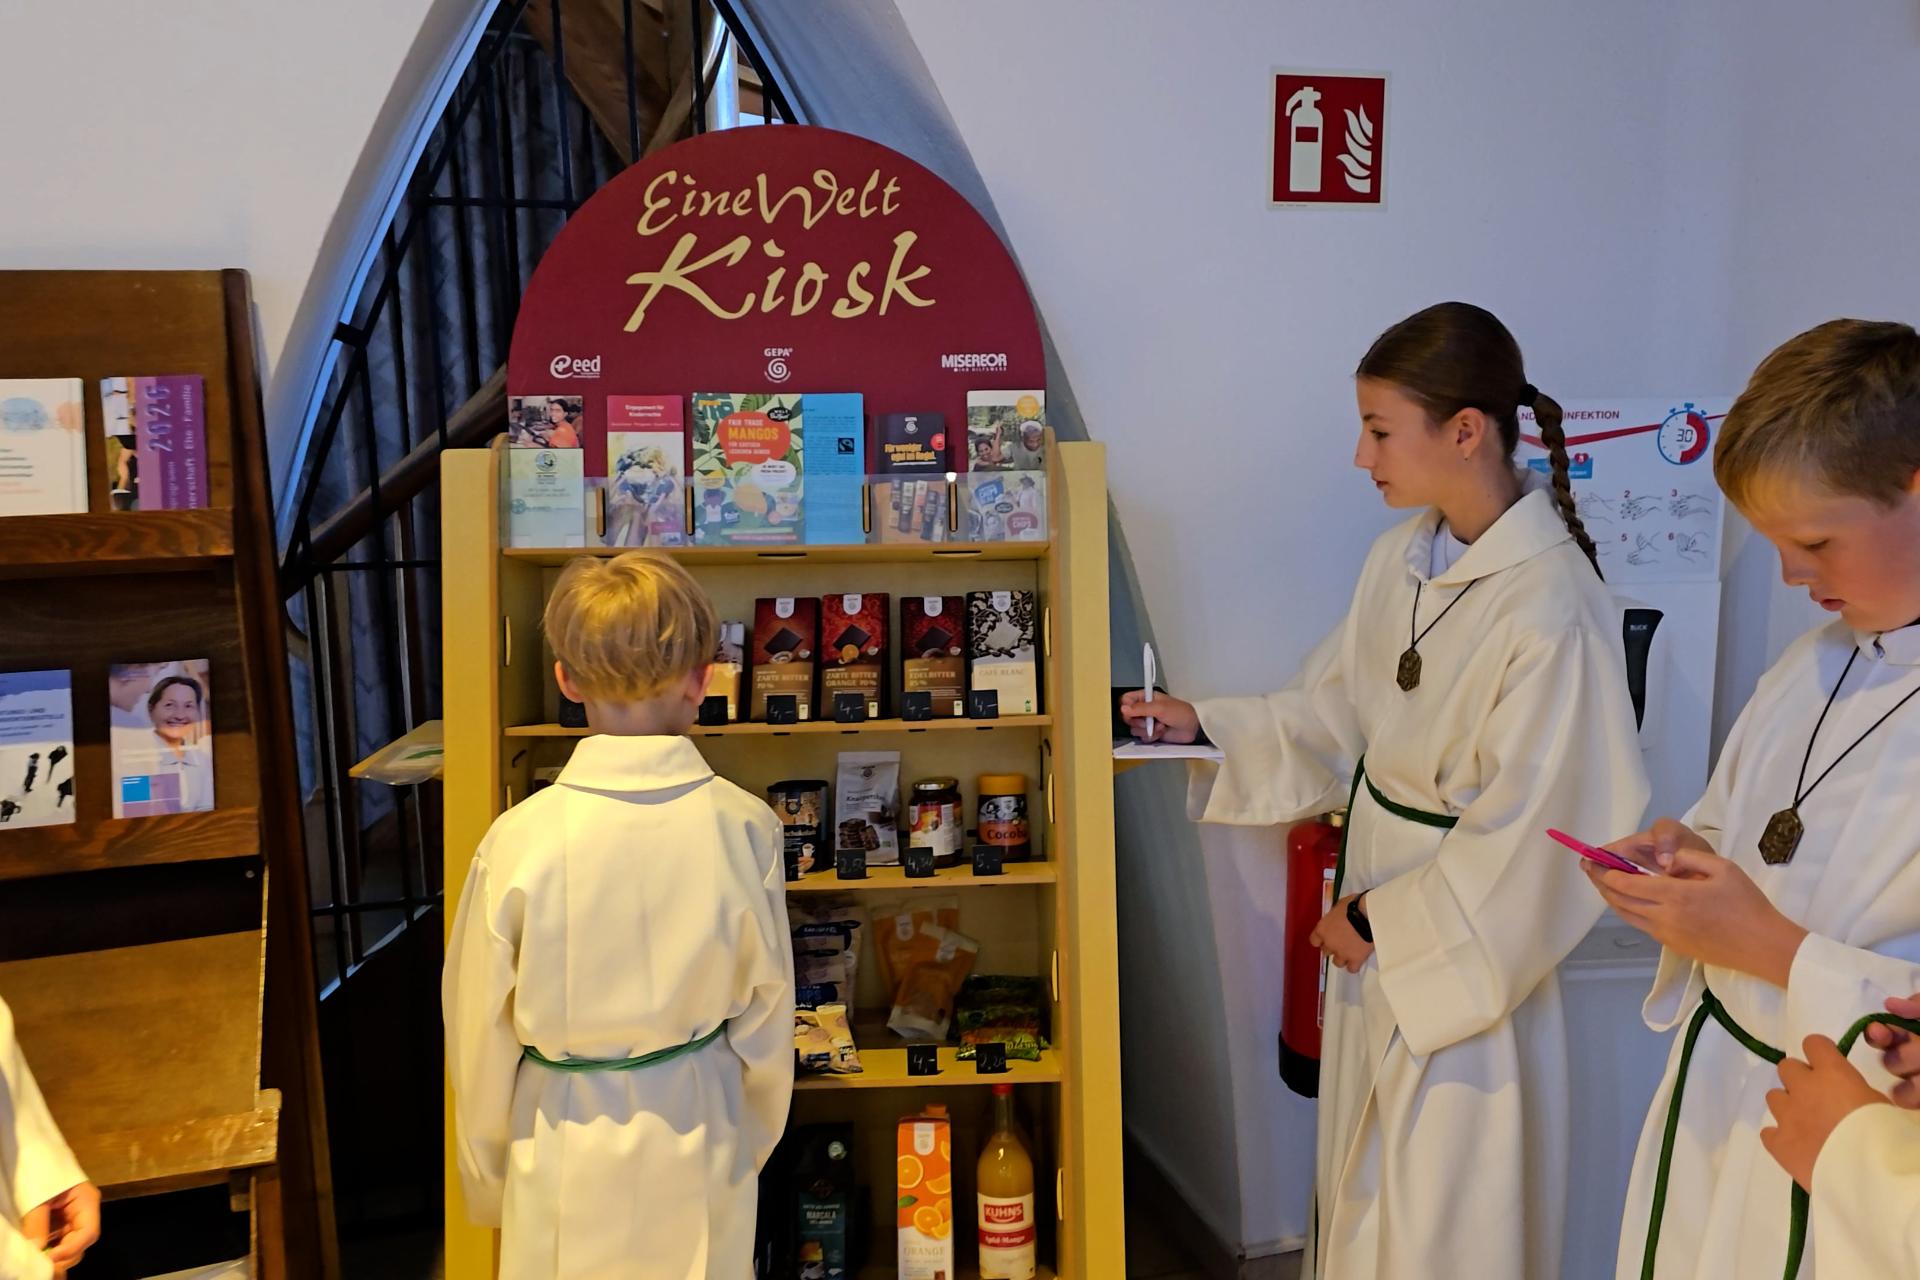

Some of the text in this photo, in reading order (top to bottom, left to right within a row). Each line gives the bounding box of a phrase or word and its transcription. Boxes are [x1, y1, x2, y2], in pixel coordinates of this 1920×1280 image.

[623, 230, 937, 333] Kiosk
[941, 353, 1007, 368] MISEREOR
[728, 427, 779, 440] MANGOS
[1676, 428, 1693, 442] 30
[185, 458, 198, 509] nerschaft
[1624, 490, 1631, 498] 2
[1671, 489, 1678, 497] 3
[909, 671, 956, 679] EDELBITTER
[825, 679, 857, 687] ORANGE
[984, 1205, 1023, 1217] KUHNS
